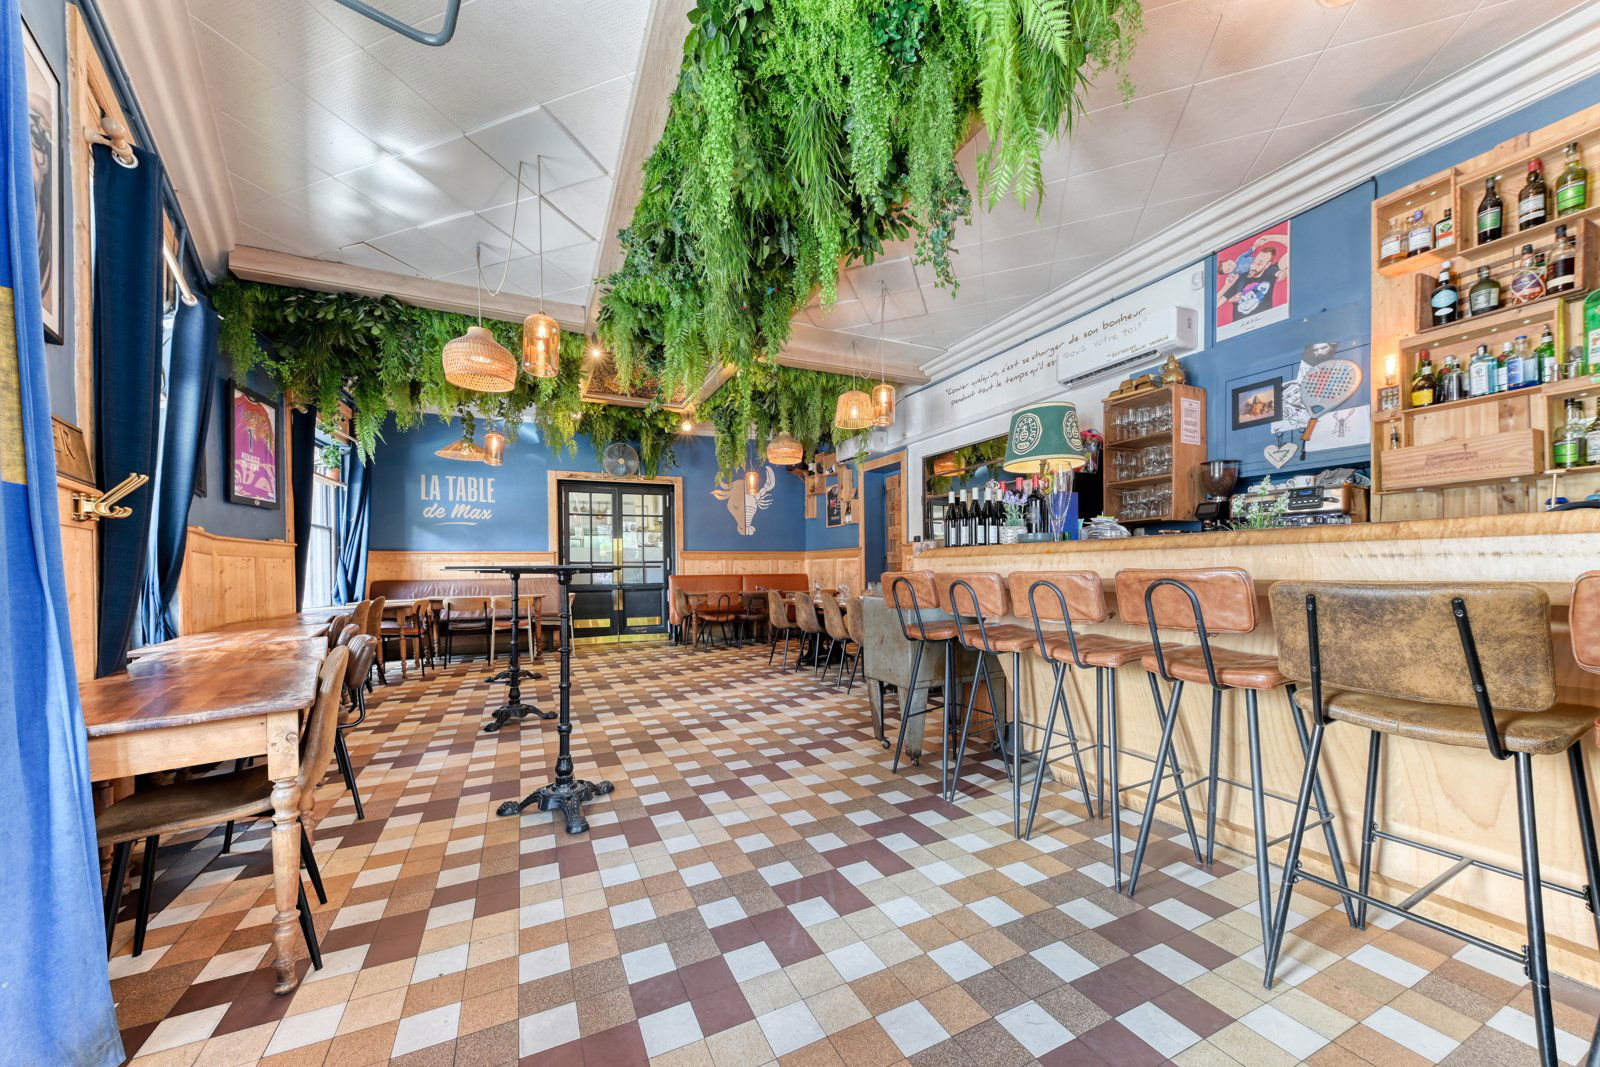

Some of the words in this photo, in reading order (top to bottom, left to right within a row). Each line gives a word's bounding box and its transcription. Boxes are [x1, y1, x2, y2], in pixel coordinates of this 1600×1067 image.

[1032, 342, 1065, 360] charger
[1068, 333, 1079, 344] de
[1083, 328, 1098, 339] son
[1102, 307, 1146, 330] bonheur
[951, 390, 975, 408] pendant
[978, 383, 994, 394] tout
[996, 380, 1002, 388] le
[1004, 371, 1029, 384] temps
[420, 474, 441, 500] LA
[445, 475, 496, 503] TABLE
[422, 502, 446, 518] de
[450, 503, 493, 520] Max
